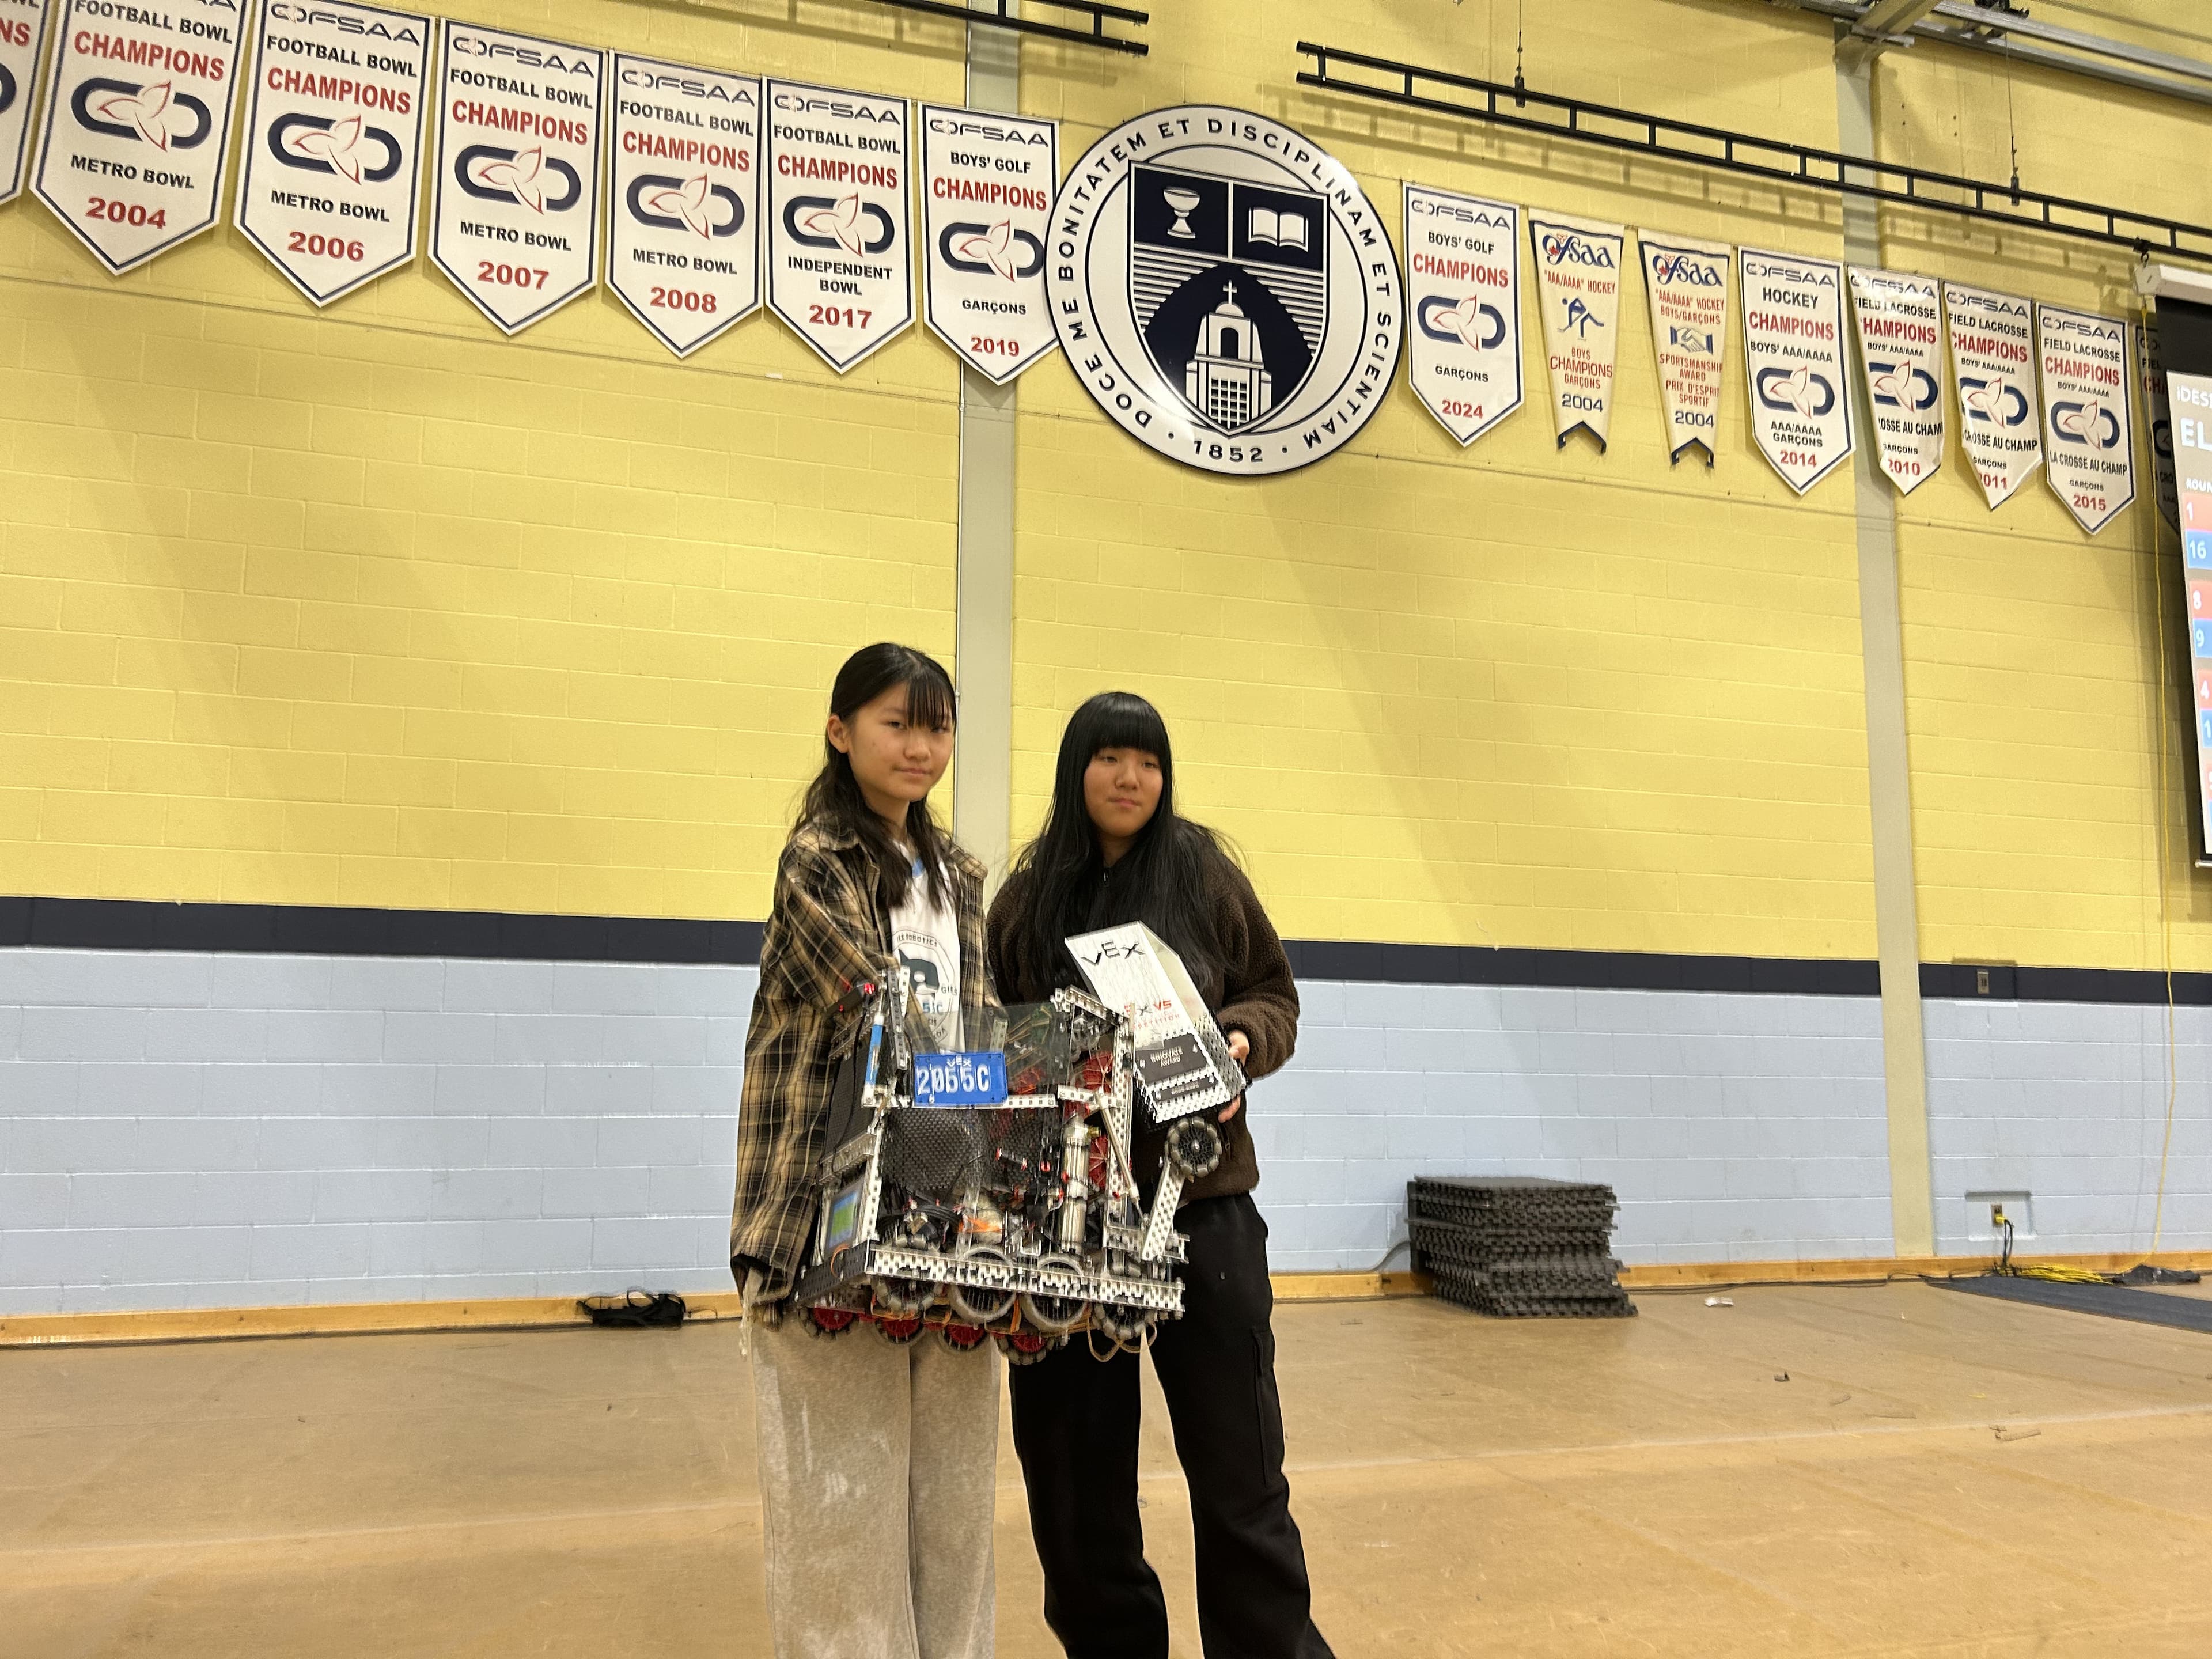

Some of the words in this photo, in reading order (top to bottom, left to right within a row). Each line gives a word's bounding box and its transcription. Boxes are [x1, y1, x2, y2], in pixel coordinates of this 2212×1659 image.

[75, 0, 173, 31] FOOTBALL
[179, 18, 232, 44] BOWL
[74, 31, 224, 81] CHAMPIONS
[267, 35, 361, 66] FOOTBALL
[367, 54, 418, 78] BOWL
[268, 67, 411, 115] CHAMPIONS
[450, 69, 539, 98] FOOTBALL
[545, 85, 593, 109] BOWL
[452, 100, 588, 146] CHAMPIONS
[620, 101, 704, 128] FOOTBALL
[709, 116, 754, 137] BOWL
[1158, 119, 1190, 138] ET
[774, 124, 854, 149] FOOTBALL
[858, 135, 901, 154] BOWL
[623, 131, 749, 172] CHAMPIONS
[70, 154, 137, 180] METRO
[143, 170, 195, 189] BOWL
[778, 154, 897, 190] CHAMPIONS
[994, 158, 1031, 174] GOLF
[933, 177, 1047, 211] CHAMPIONS
[1207, 118, 1377, 248] DISCIPLINAM
[85, 197, 166, 229] 2004
[271, 190, 334, 213] METRO
[340, 203, 390, 222] BOWL
[1058, 132, 1147, 282] BONITATEM
[287, 231, 365, 262] 2006
[460, 221, 519, 243] METRO
[525, 234, 571, 252] BOWL
[1465, 238, 1494, 255] GOLF
[632, 248, 688, 268] METRO
[693, 258, 737, 275] BOWL
[788, 256, 893, 280] INDEPENDENT
[1413, 253, 1509, 289] CHAMPIONS
[478, 261, 550, 290] 2007
[1371, 261, 1391, 297] ET
[819, 279, 862, 296] BOWL
[1588, 281, 1615, 294] HOCKEY
[1763, 287, 1819, 309] HOCKEY
[650, 287, 717, 314] 2008
[962, 300, 1027, 315] GARÇONS
[1696, 297, 1724, 312] HOCKEY
[1884, 301, 1936, 319] LACROSSE
[809, 305, 872, 329] 2017
[1062, 298, 1087, 341] ME
[1661, 305, 1721, 325] BOYS/GARÇONS
[1749, 311, 1834, 342] CHAMPIONS
[1948, 313, 1976, 327] FIELD
[1979, 318, 2028, 338] LACROSSE
[1860, 317, 1936, 344] HAMPIONS
[971, 337, 1020, 357] 2019
[1571, 346, 1590, 360] BOYS
[2044, 338, 2071, 352] FIELD
[2073, 342, 2120, 362] LACROSSE
[1435, 365, 1489, 383] GARÇONS
[1550, 356, 1612, 378] CHAMPIONS
[1659, 353, 1723, 372] SPORTSMANSHIP
[2045, 356, 2120, 387] CHAMPIONS
[1303, 310, 1392, 450] SCIENTIAM
[1565, 373, 1600, 389] GARÇONS
[1679, 368, 1706, 382] AWARD
[1084, 354, 1153, 429] DOCE
[1666, 381, 1684, 393] PRIX
[1442, 400, 1484, 419] 2024
[1562, 393, 1603, 412] 2004
[1679, 393, 1709, 408] SPORTIF
[1675, 411, 1714, 428] 2004
[1878, 418, 1901, 433] OSSE
[1903, 422, 1913, 434] AU
[1192, 440, 1264, 463] 1852
[1773, 433, 1823, 448] GARÇONS
[1964, 429, 1991, 448] CROSSE
[1993, 436, 2003, 449] AU
[2005, 438, 2037, 452] CHAMP
[1780, 450, 1817, 468] 2014
[1973, 456, 2007, 469] GARÇONS
[2050, 450, 2058, 463] LA
[2059, 453, 2088, 469] CROSSE
[2089, 458, 2100, 472] AU
[2101, 460, 2127, 476] CHAMP
[2069, 479, 2104, 493] GARÇONS
[2073, 494, 2106, 512] 2015
[2186, 502, 2194, 519] 1
[2190, 540, 2207, 559] 16
[2192, 590, 2202, 610] 8
[2196, 628, 2205, 647] 9
[2200, 680, 2210, 700] 4
[1081, 941, 1145, 966] VEX
[1153, 1000, 1172, 1011] V5
[1160, 1056, 1180, 1067] AWARD
